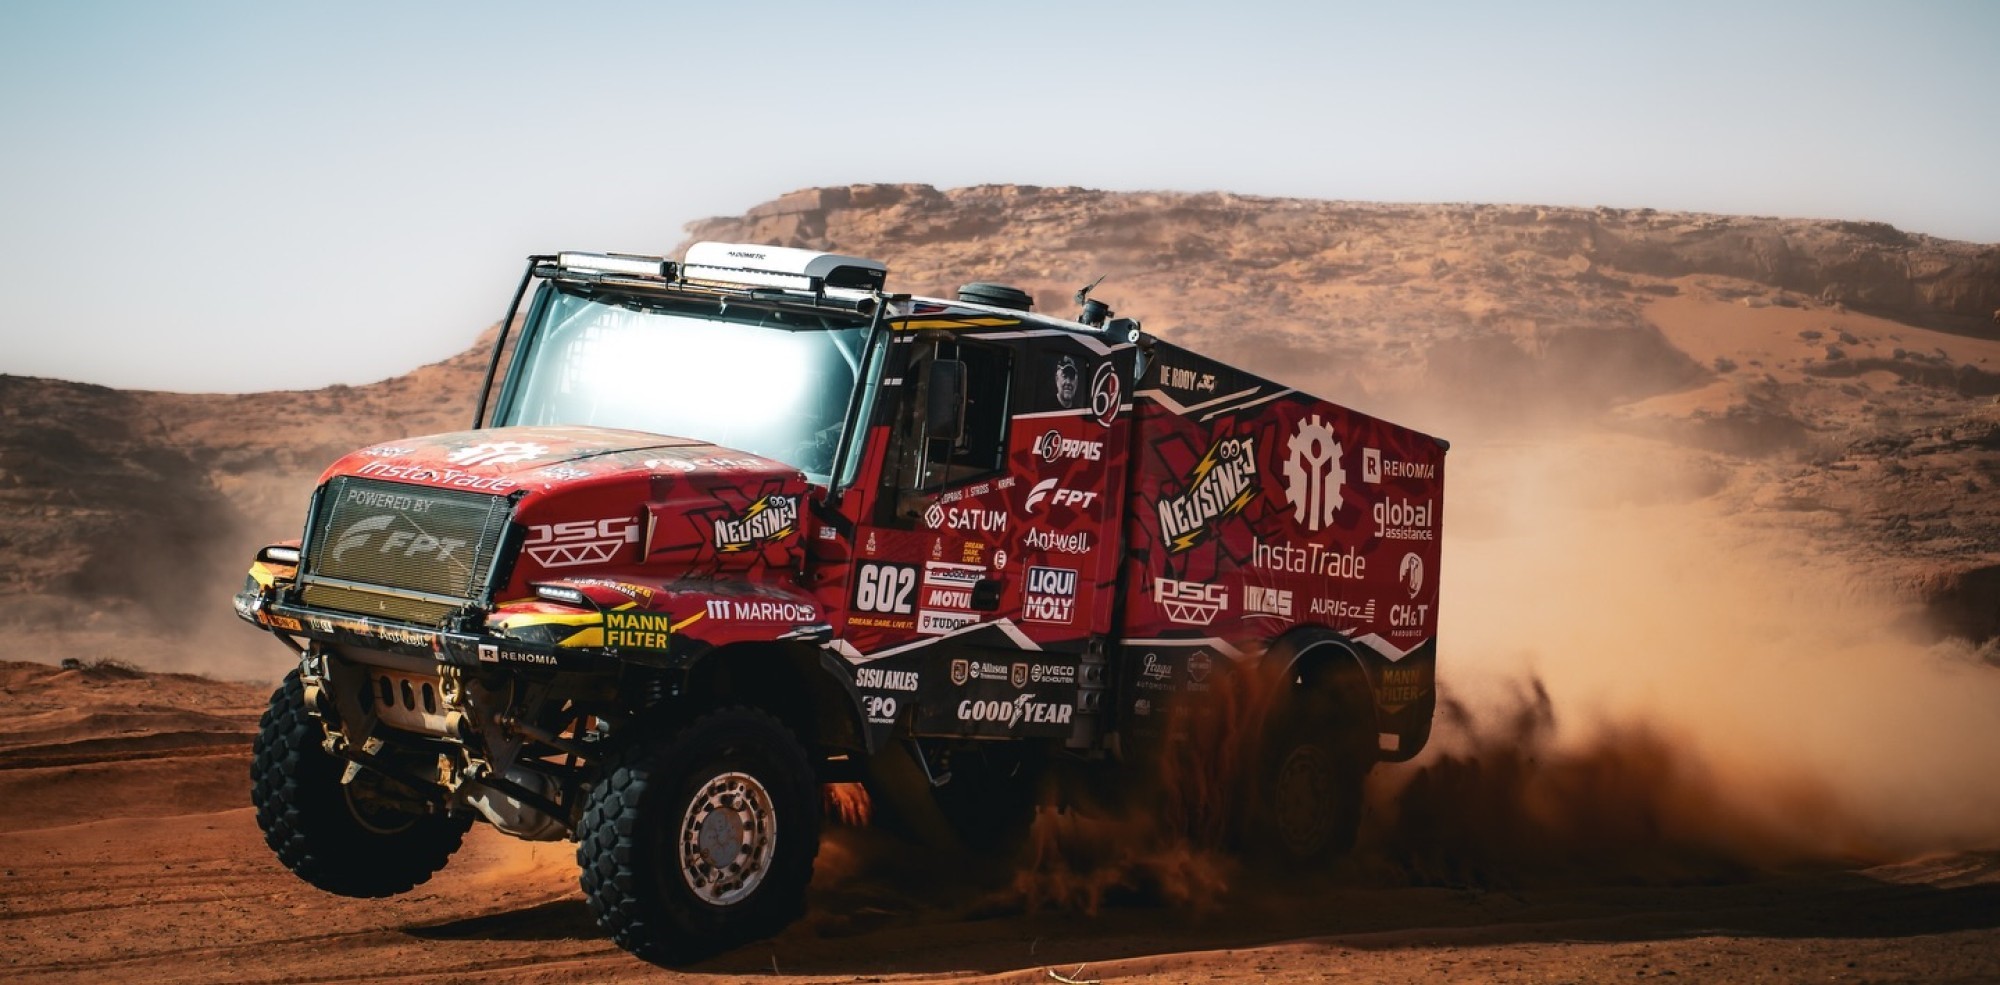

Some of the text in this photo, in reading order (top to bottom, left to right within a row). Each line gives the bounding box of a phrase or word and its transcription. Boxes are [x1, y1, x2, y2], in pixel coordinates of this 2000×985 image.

[1172, 367, 1197, 391] ROOY
[1384, 459, 1435, 480] RENOMIA
[347, 489, 434, 513] POWERED BY
[1051, 489, 1098, 509] FPT
[947, 508, 1008, 532] SATUM
[1374, 496, 1433, 537] global
[379, 530, 467, 560] FPT
[1385, 526, 1434, 541] assistance
[1253, 536, 1366, 580] InstaTrade
[856, 564, 916, 614] 602
[1028, 569, 1075, 593] LIQUI
[734, 602, 816, 621] MARHOLD
[1025, 595, 1072, 620] MOLY
[1390, 604, 1429, 627] CH&T
[607, 613, 668, 632] MANN
[607, 631, 667, 649] FILTER
[501, 651, 558, 666] RENOMIA
[1042, 664, 1075, 676] IVECO
[856, 668, 919, 691] SISU AXLES
[1383, 670, 1419, 683] MANN
[957, 697, 1073, 727] GOODYEAR
